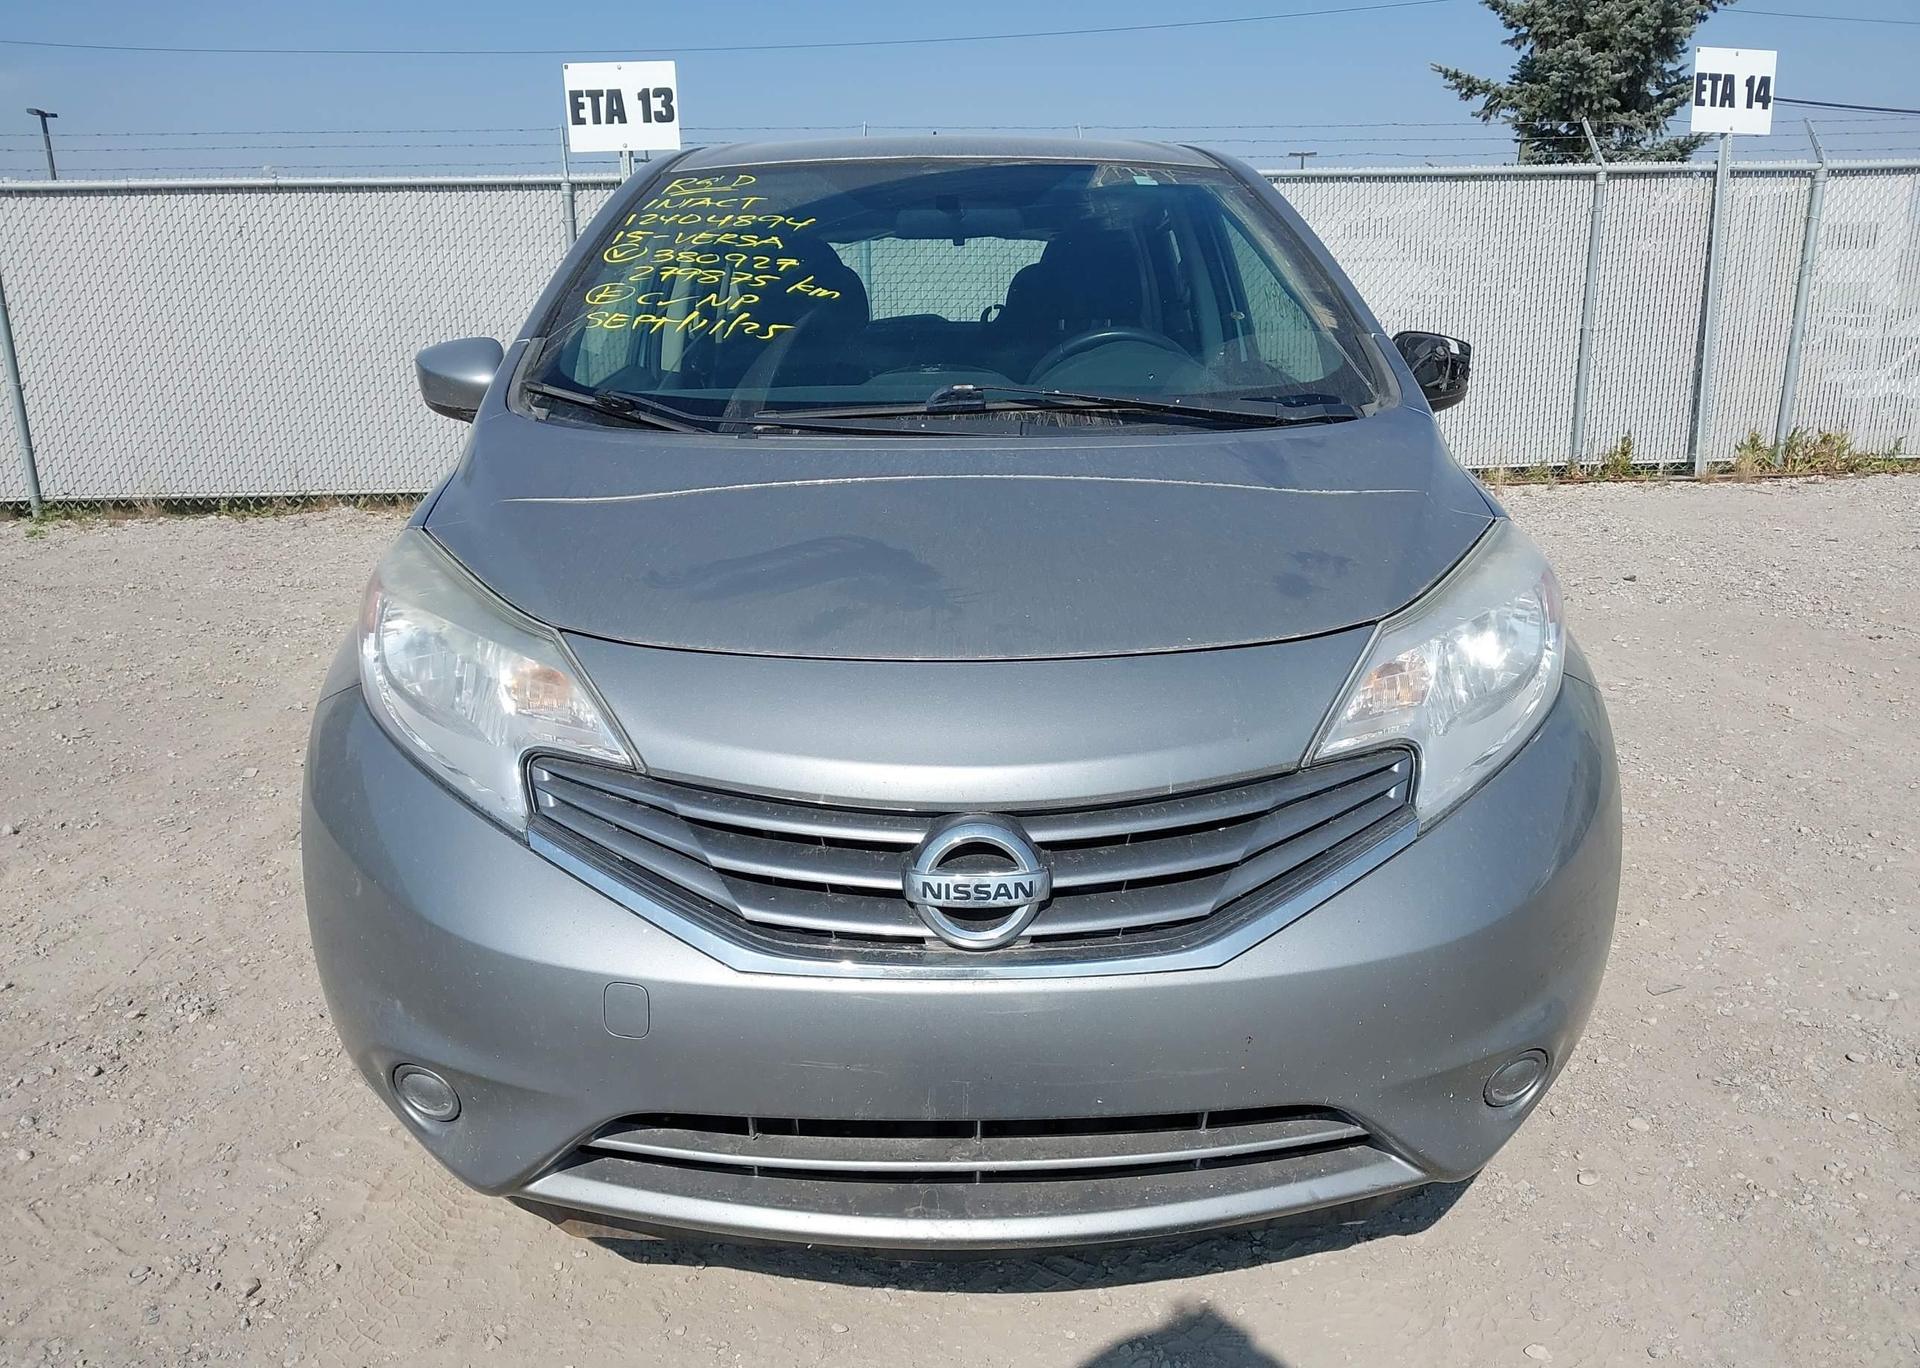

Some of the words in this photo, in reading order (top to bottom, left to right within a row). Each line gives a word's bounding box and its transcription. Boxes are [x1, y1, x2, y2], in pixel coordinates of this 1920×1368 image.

[1694, 72, 1735, 108] ETA
[1745, 75, 1772, 110] 14
[568, 88, 628, 125] ETA
[637, 87, 675, 123] 13
[642, 197, 768, 211] INTACT
[624, 213, 816, 232] 12404894
[650, 249, 800, 271] 380927
[628, 265, 782, 287] 279875
[922, 880, 1034, 901] NISSAN
